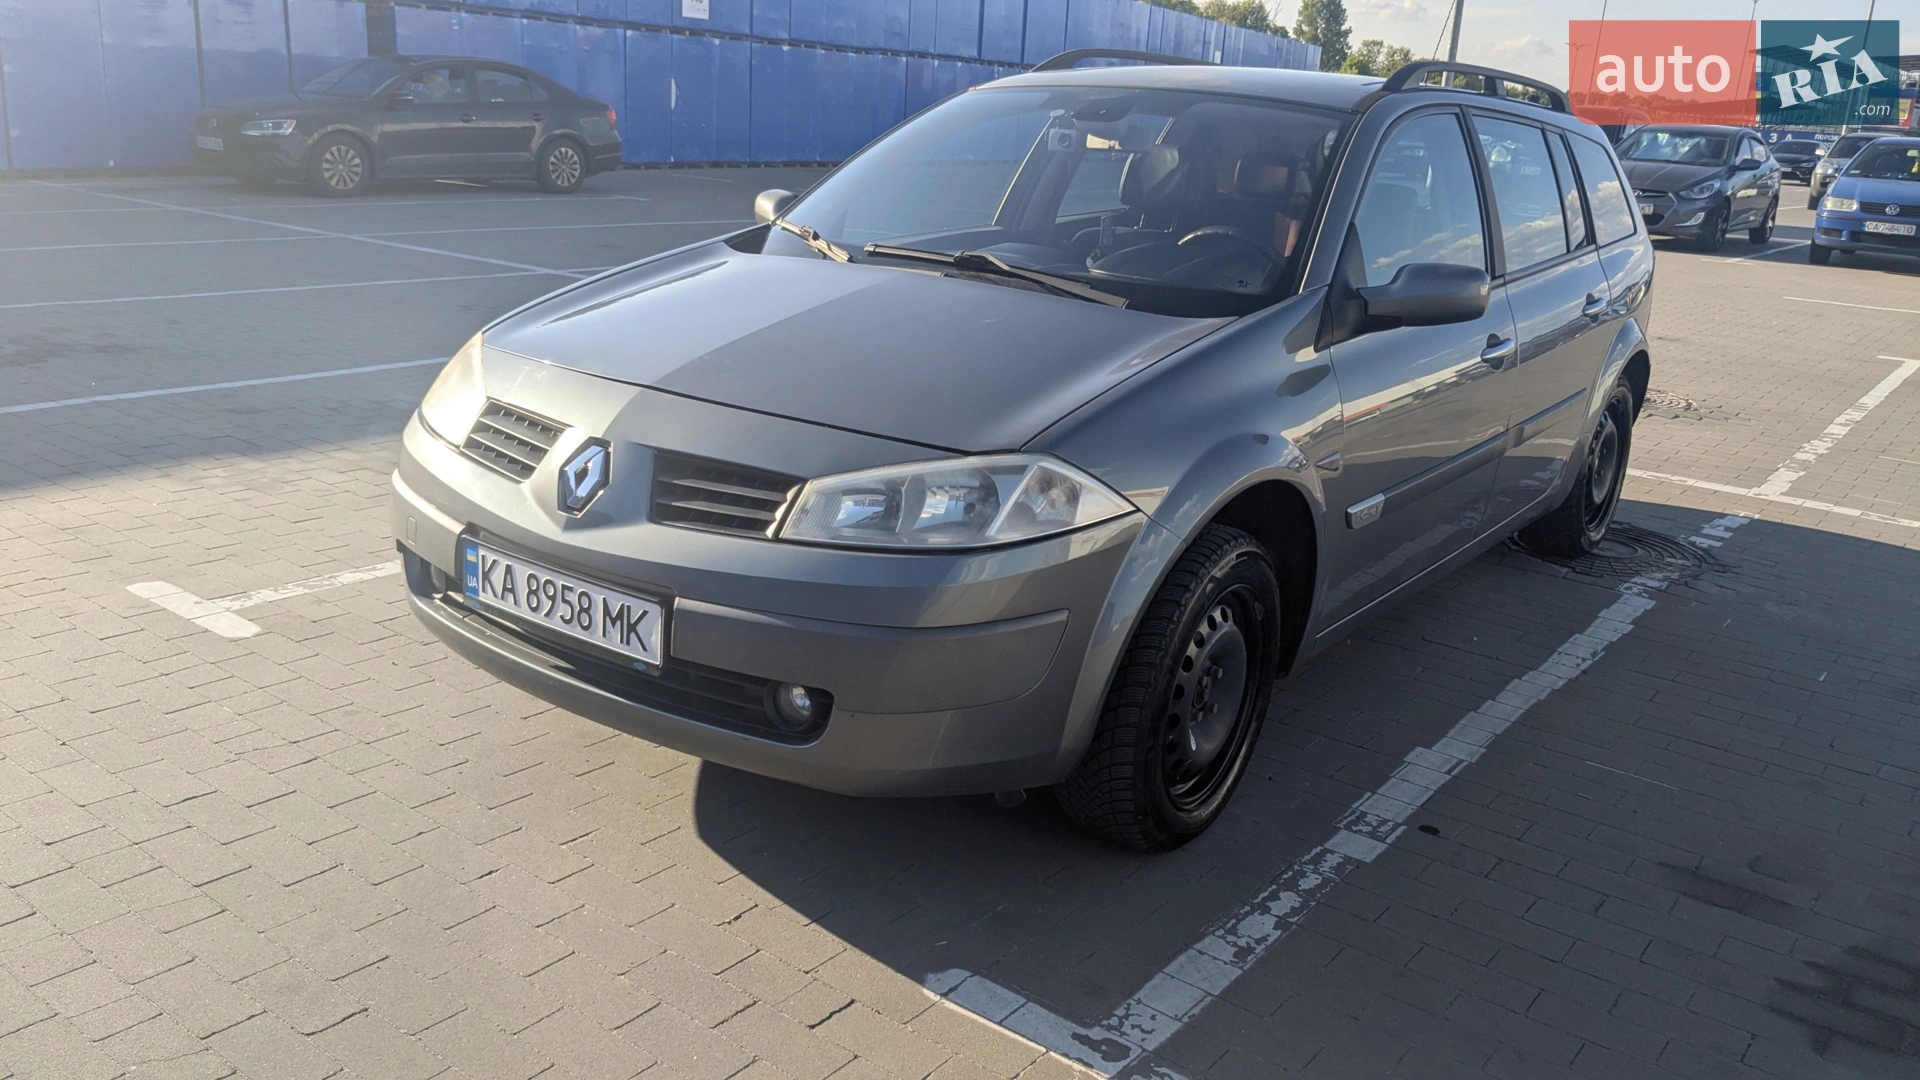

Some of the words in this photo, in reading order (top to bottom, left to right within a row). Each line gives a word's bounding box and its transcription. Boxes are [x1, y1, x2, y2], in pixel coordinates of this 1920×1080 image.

[1866, 222, 1879, 231] CA
[467, 574, 478, 590] UA
[481, 553, 518, 606] KA
[526, 572, 593, 632] 8958
[602, 595, 650, 652] MK
